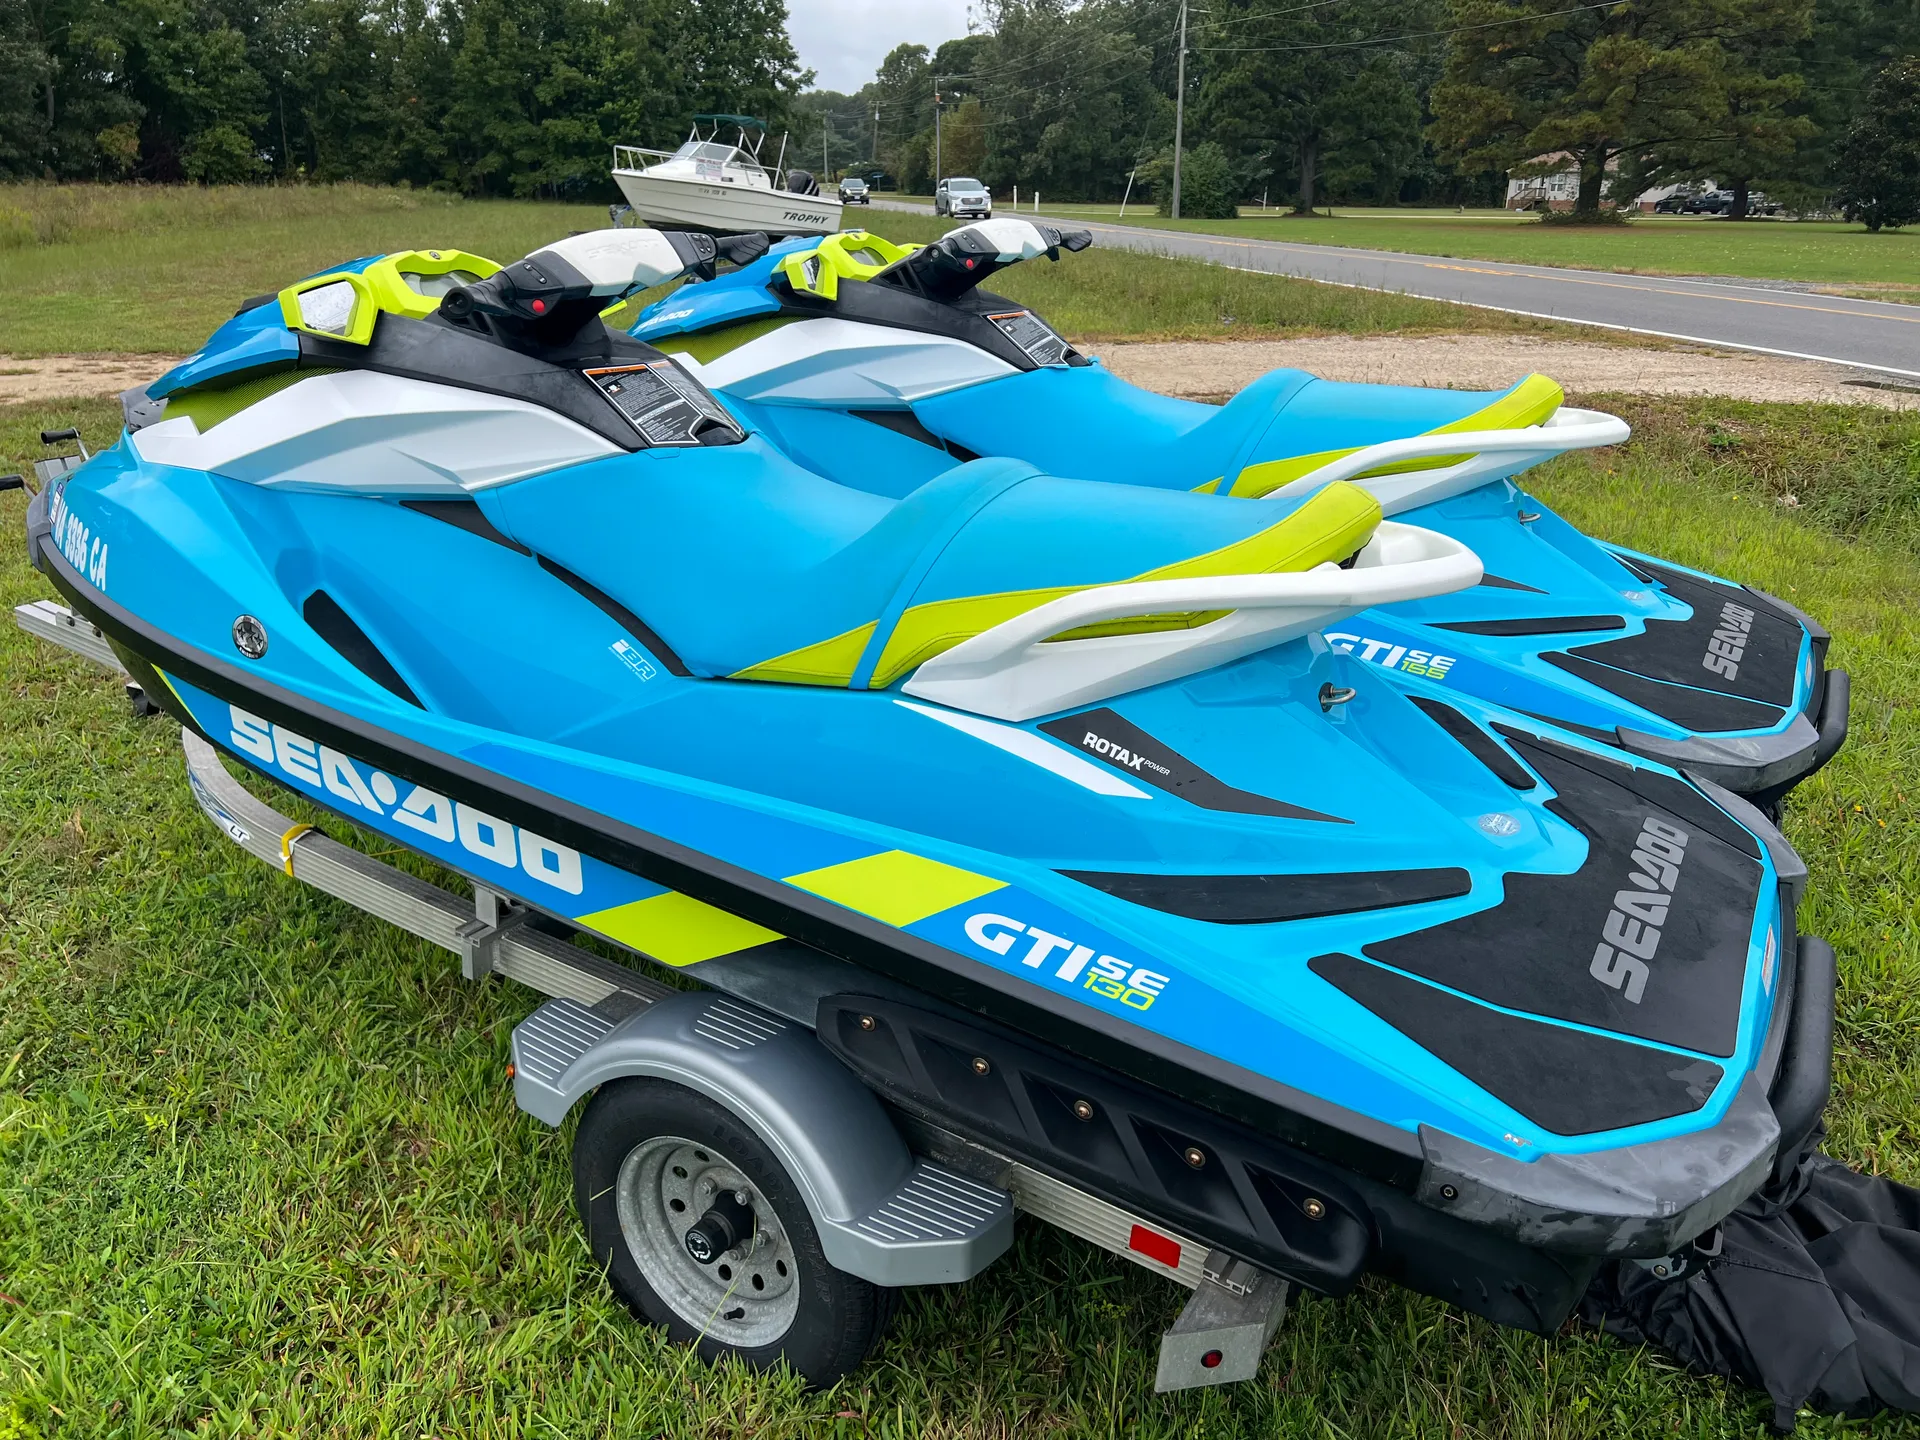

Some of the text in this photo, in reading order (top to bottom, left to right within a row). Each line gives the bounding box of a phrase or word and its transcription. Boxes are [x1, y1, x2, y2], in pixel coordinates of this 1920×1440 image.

[782, 211, 829, 225] TROPHY
[89, 536, 108, 591] CA
[1323, 632, 1457, 674] GTI SE
[1400, 660, 1446, 680] 155
[1082, 731, 1171, 776] ROTAX POWER
[230, 825, 248, 839] LT
[964, 912, 1171, 997] GTI SE
[1082, 971, 1156, 1011] 130
